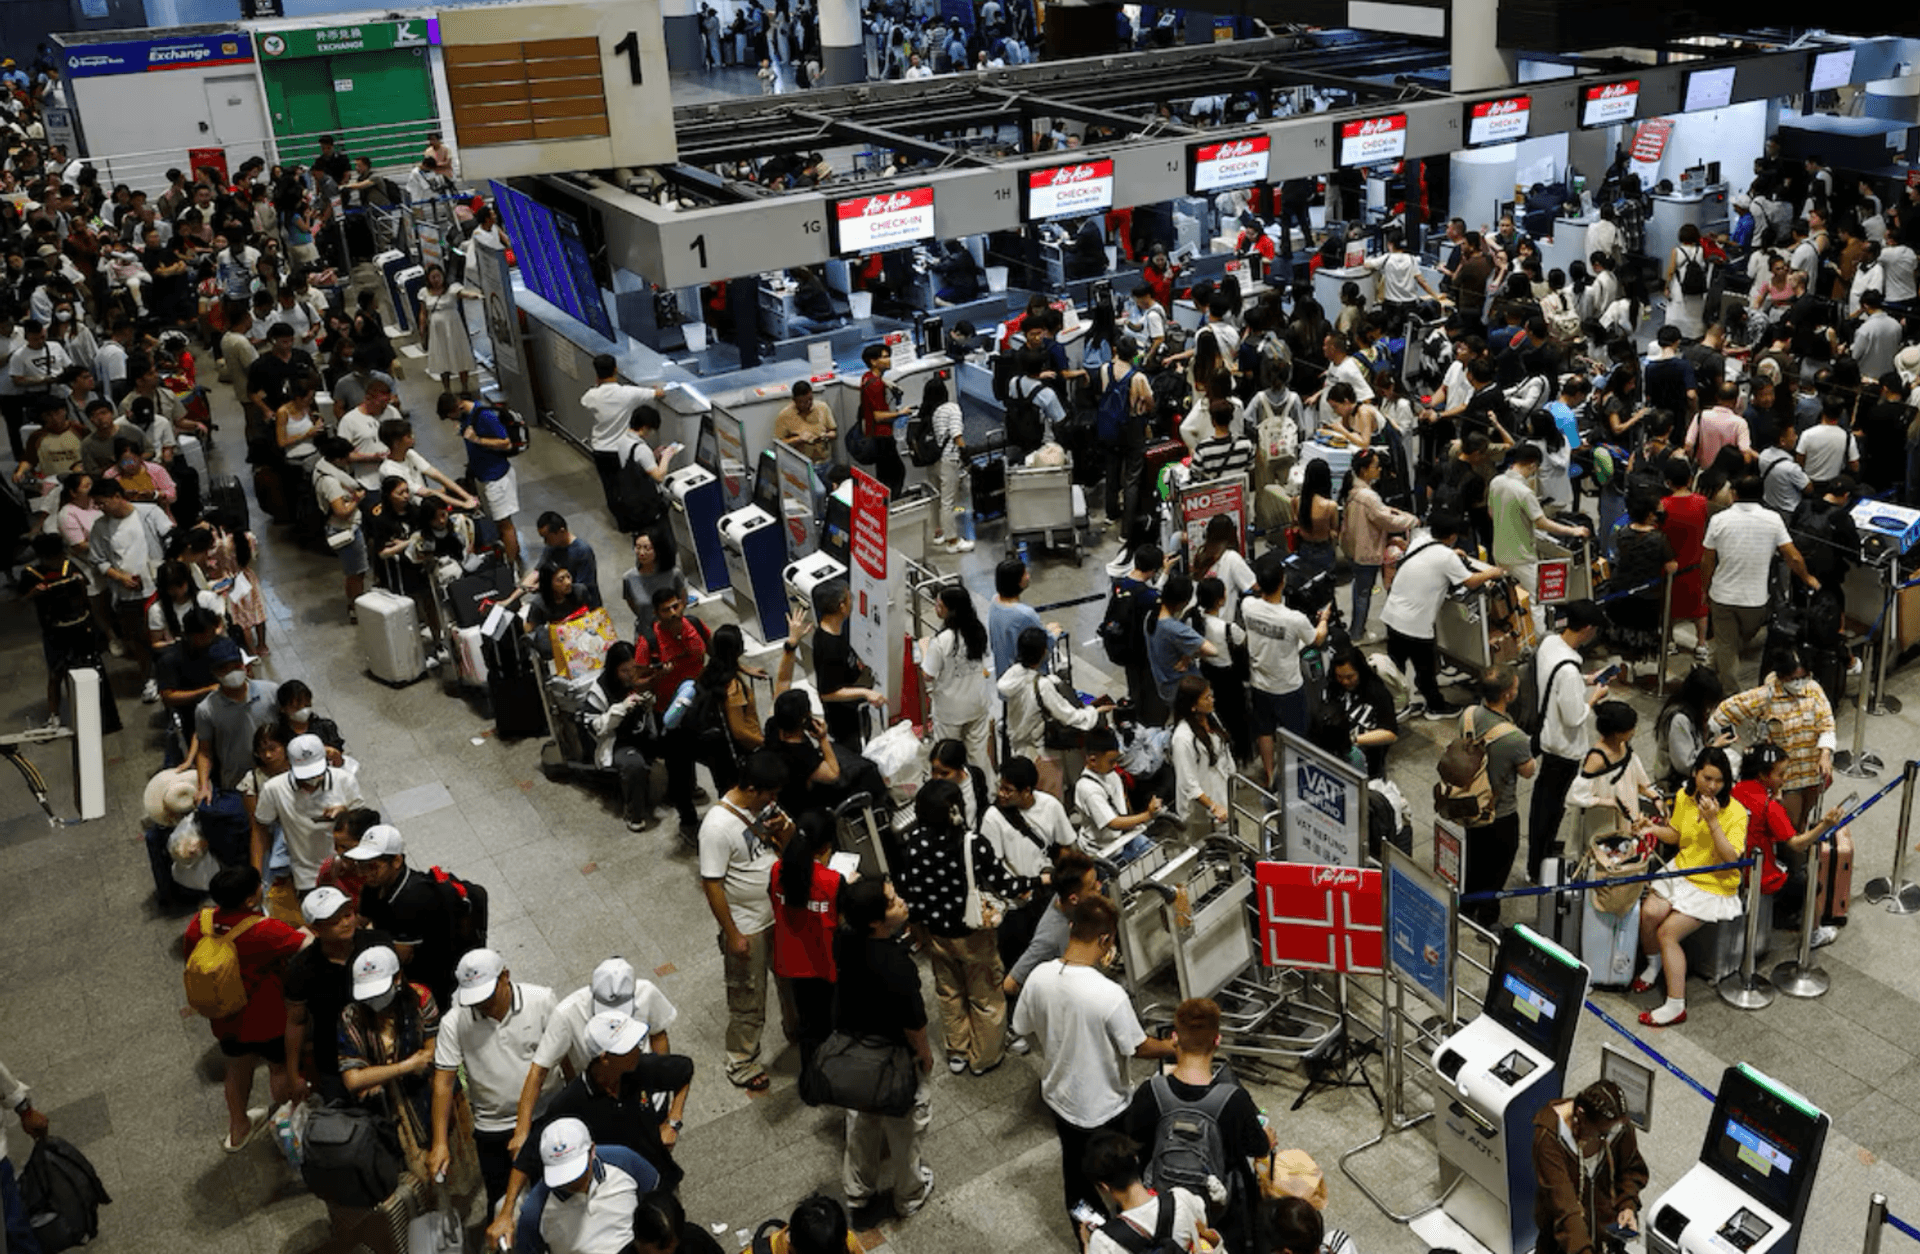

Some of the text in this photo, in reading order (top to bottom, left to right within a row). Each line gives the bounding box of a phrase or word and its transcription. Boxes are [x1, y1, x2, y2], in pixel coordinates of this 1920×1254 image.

[149, 47, 211, 61] Exchange
[317, 41, 364, 52] EXCHANGE
[614, 31, 642, 85] 1
[1314, 135, 1326, 148] 1K
[1167, 160, 1179, 172] 1J
[994, 188, 1011, 200] 1H
[1056, 186, 1103, 201] CHECK-IN
[802, 221, 822, 234] 1G
[870, 216, 922, 232] CHECK-IN
[690, 234, 707, 268] 1
[1186, 495, 1211, 512] NO
[1302, 764, 1341, 803] VAT
[1296, 815, 1312, 832] VAT
[1313, 827, 1348, 855] REFUND
